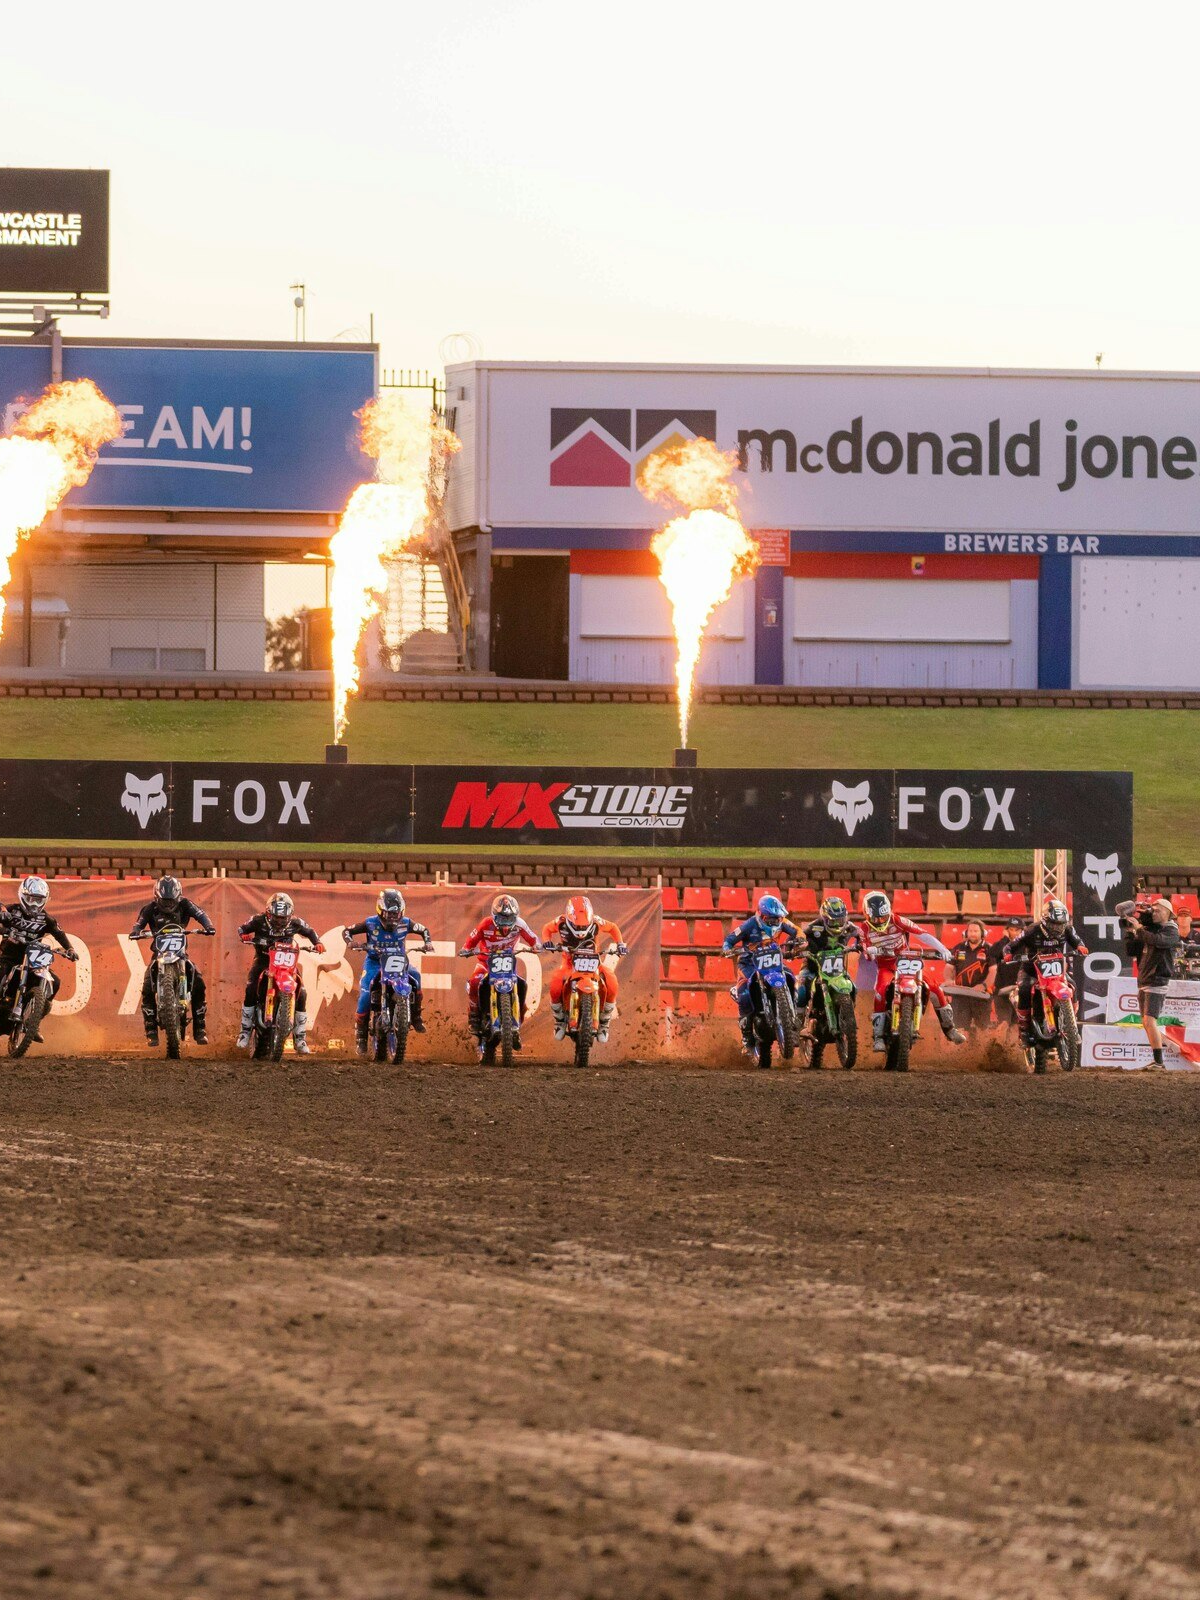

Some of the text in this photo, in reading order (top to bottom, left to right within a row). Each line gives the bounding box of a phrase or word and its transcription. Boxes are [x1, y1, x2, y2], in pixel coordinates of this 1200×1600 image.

[1057, 419, 1197, 492] jone
[944, 534, 1099, 553] BREWERS BAR
[192, 779, 311, 825] FOX
[899, 786, 1015, 831] FOX
[600, 817, 682, 828] .COM.AU
[161, 937, 183, 952] 75
[29, 949, 53, 966] 14
[274, 951, 296, 967] 99
[385, 955, 405, 972] 6
[492, 956, 513, 973] 36
[574, 958, 600, 972] 199
[756, 953, 781, 970] 754
[821, 957, 844, 973] 44
[1041, 961, 1062, 977] 20
